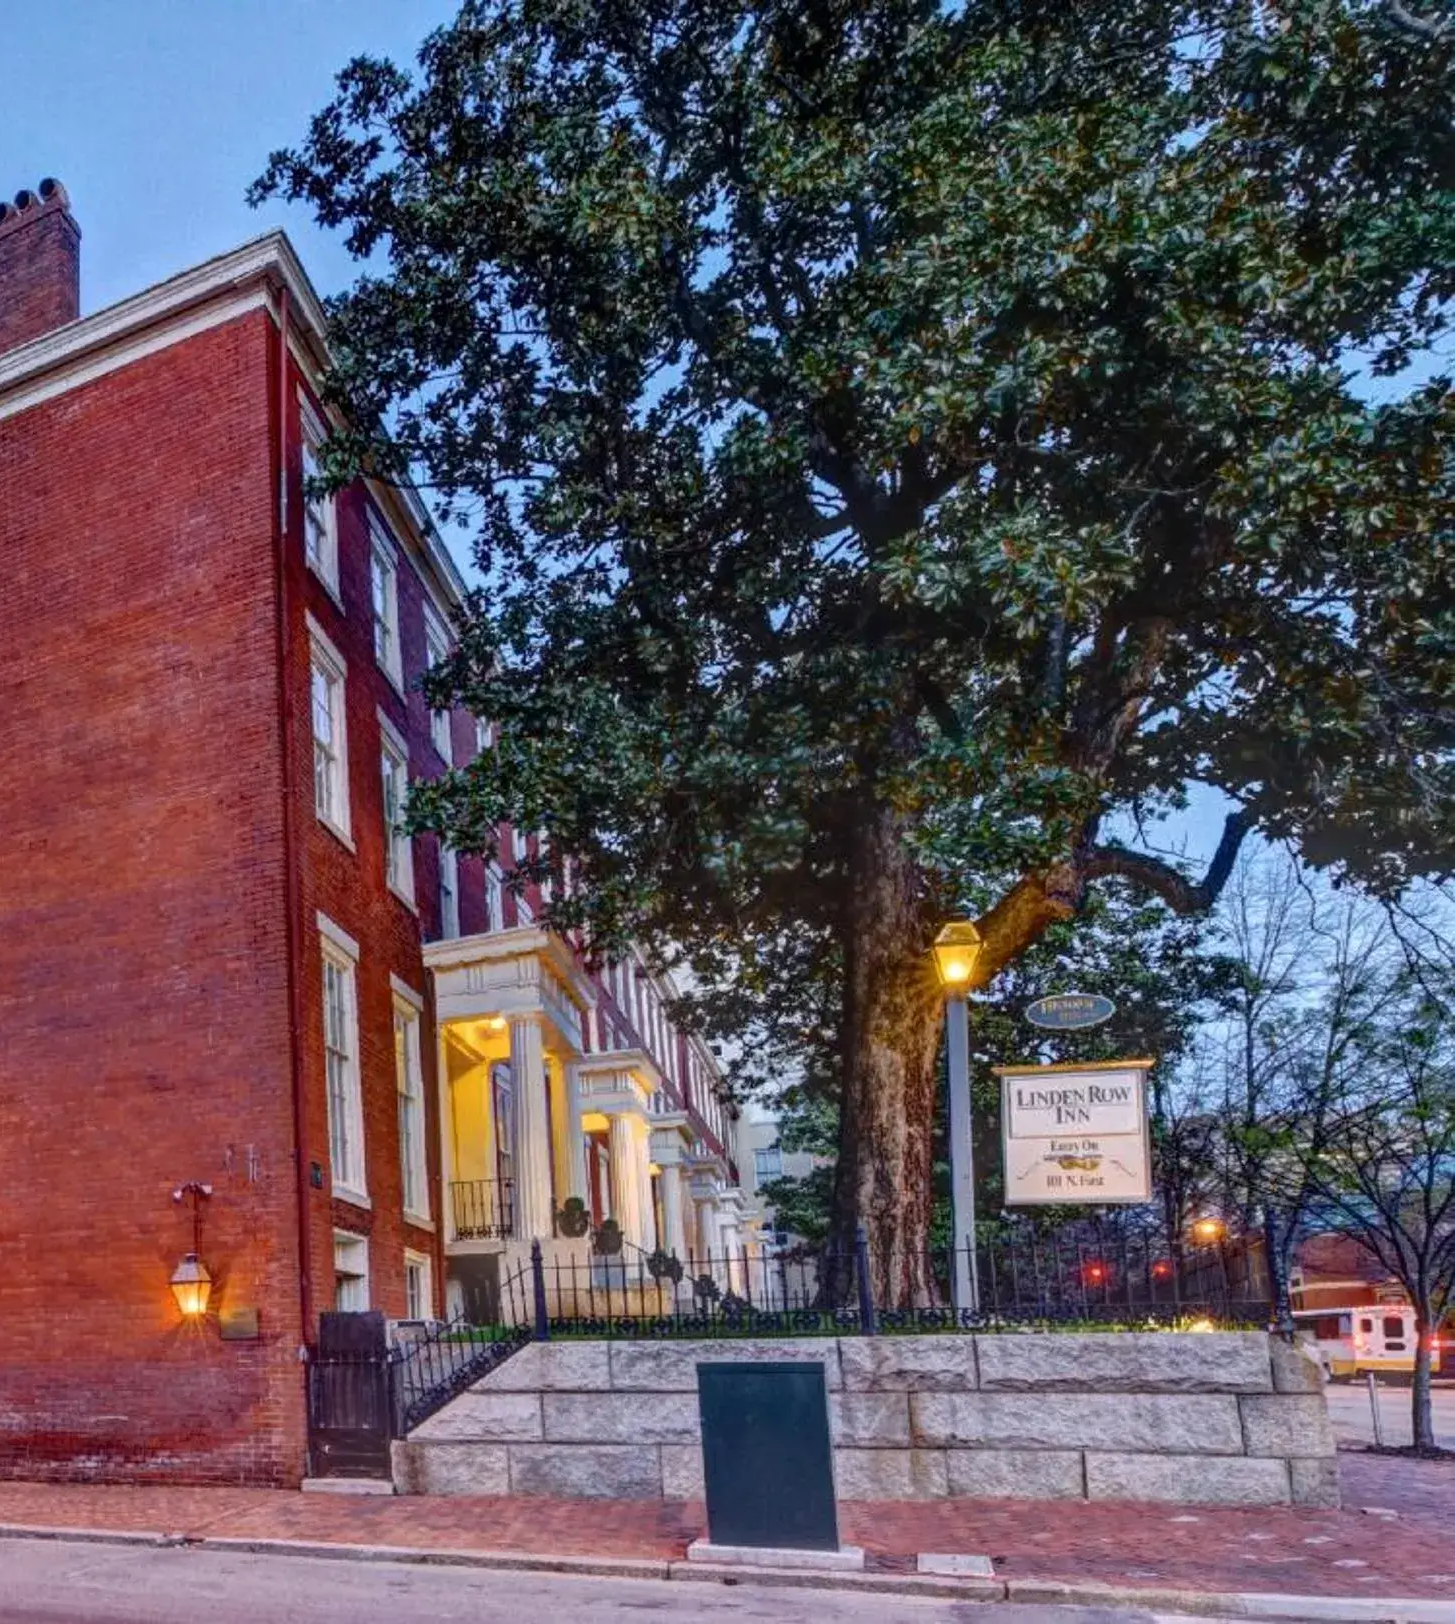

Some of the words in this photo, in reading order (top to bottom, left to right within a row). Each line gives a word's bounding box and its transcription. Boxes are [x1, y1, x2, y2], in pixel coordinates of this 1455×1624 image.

[1016, 1088, 1086, 1107] LINDEN
[1088, 1084, 1132, 1104] ROW
[1055, 1106, 1091, 1124] INN
